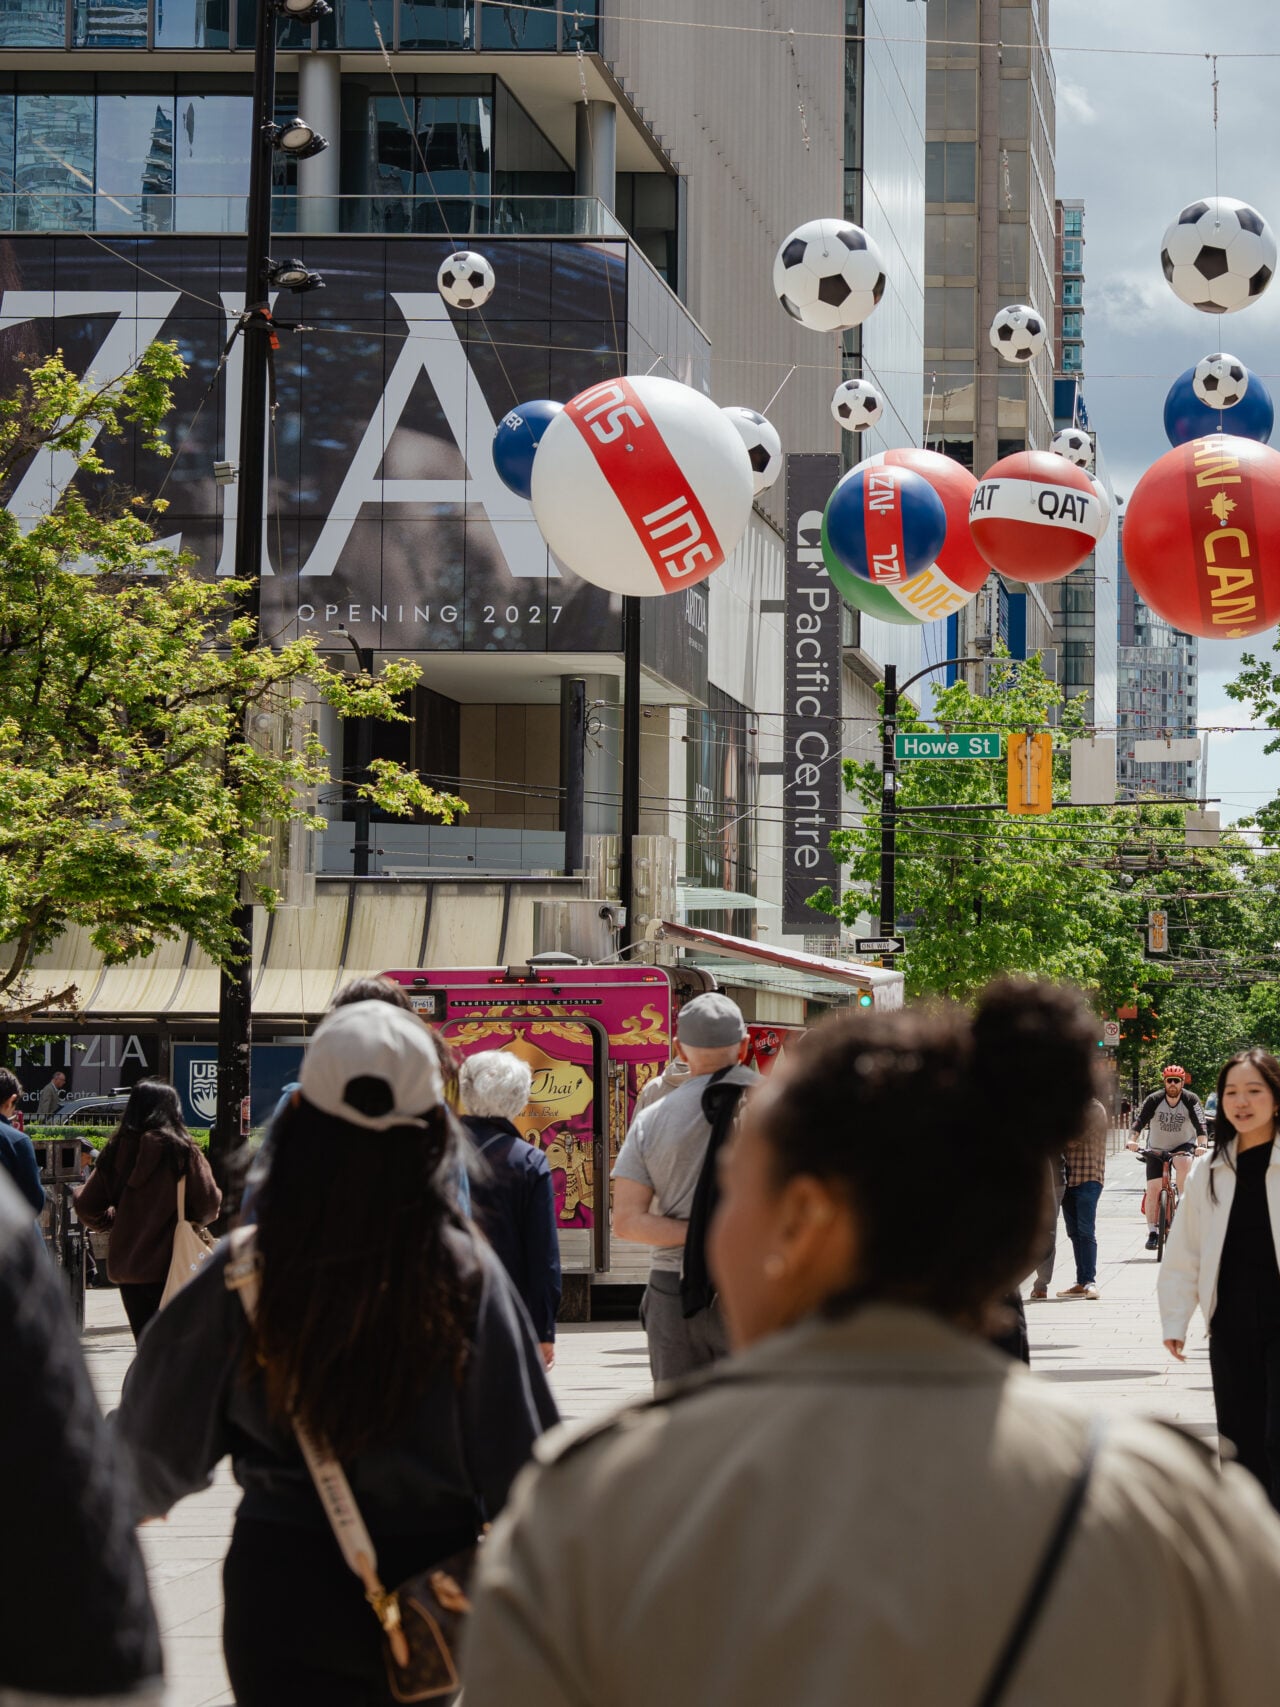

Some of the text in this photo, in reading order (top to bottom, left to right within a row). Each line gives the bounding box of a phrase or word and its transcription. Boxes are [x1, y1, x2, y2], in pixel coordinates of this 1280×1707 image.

[1038, 489, 1089, 524] QAT
[872, 544, 902, 585] NZL
[1203, 527, 1257, 625] CAN
[297, 604, 565, 625] OPENING 2027
[796, 588, 830, 718] Pacific
[904, 737, 990, 755] Howe St
[794, 731, 829, 869] Centre
[860, 942, 890, 950] ONE WAY
[193, 1063, 218, 1078] UB
[529, 1068, 572, 1095] Thai
